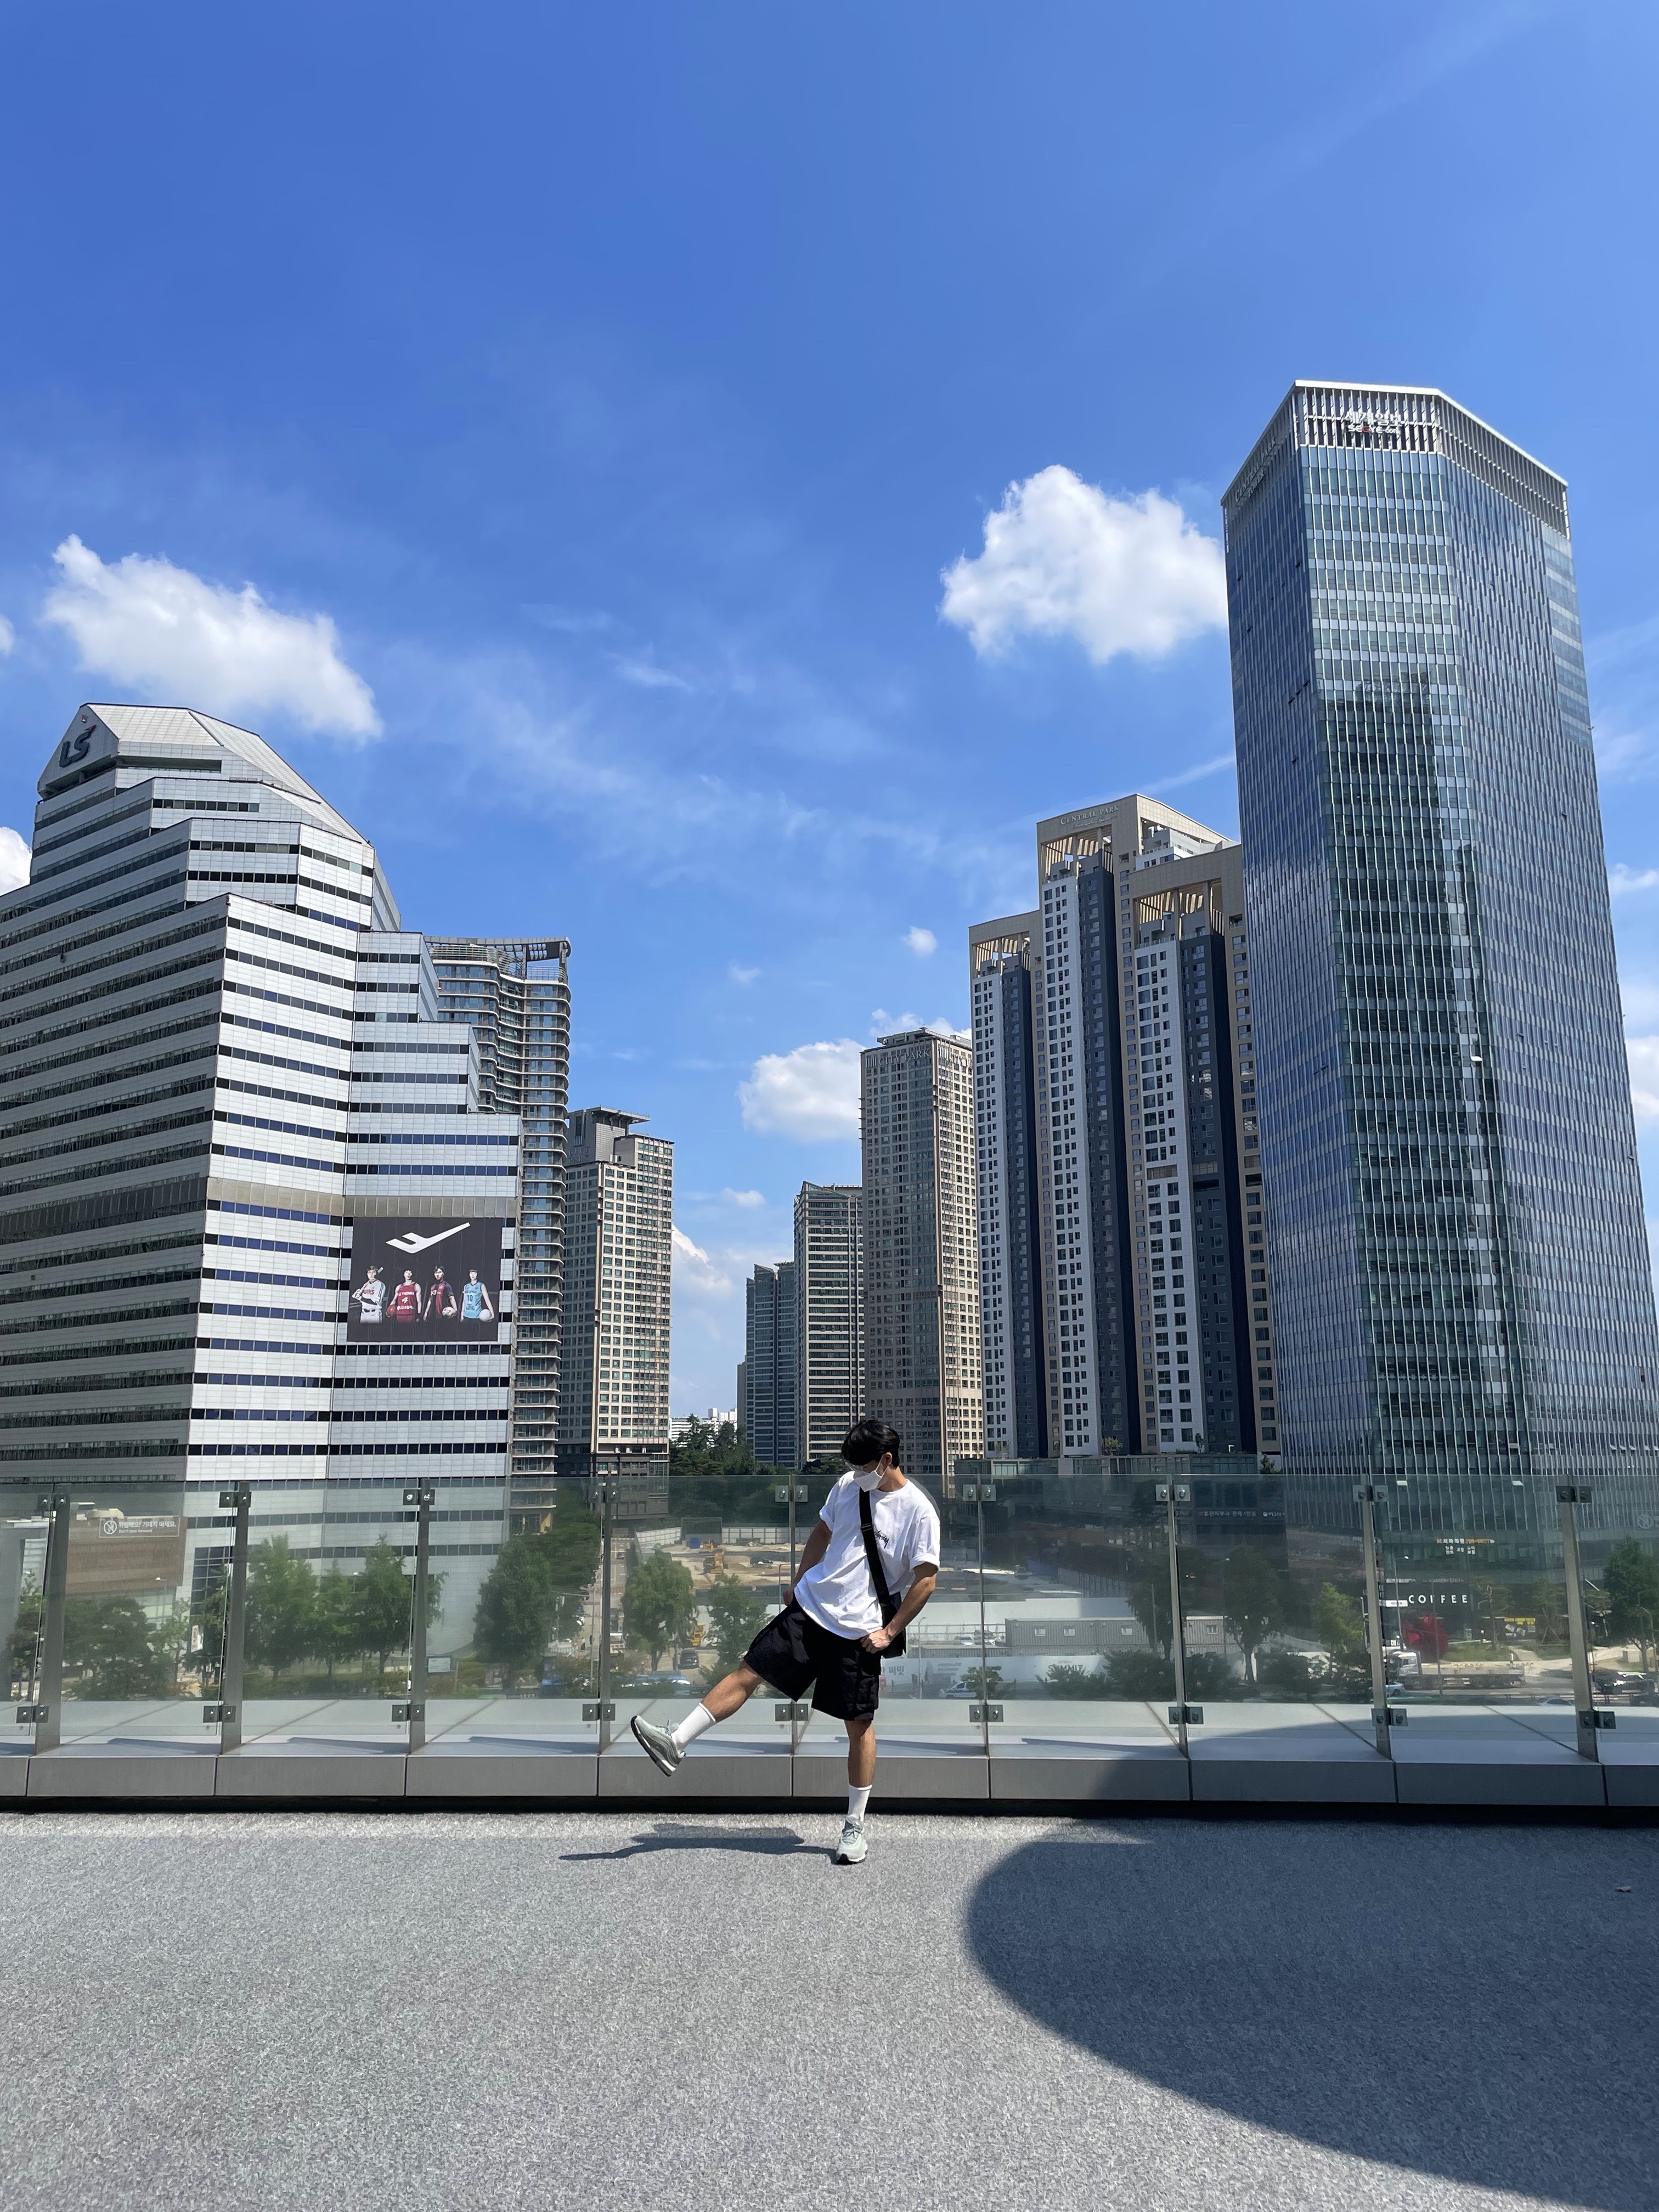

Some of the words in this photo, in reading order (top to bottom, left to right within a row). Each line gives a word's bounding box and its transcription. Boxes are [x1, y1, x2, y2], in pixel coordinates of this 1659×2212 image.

[59, 725, 96, 768] LS
[878, 1054, 901, 1066] CITY
[904, 1048, 930, 1063] PARK
